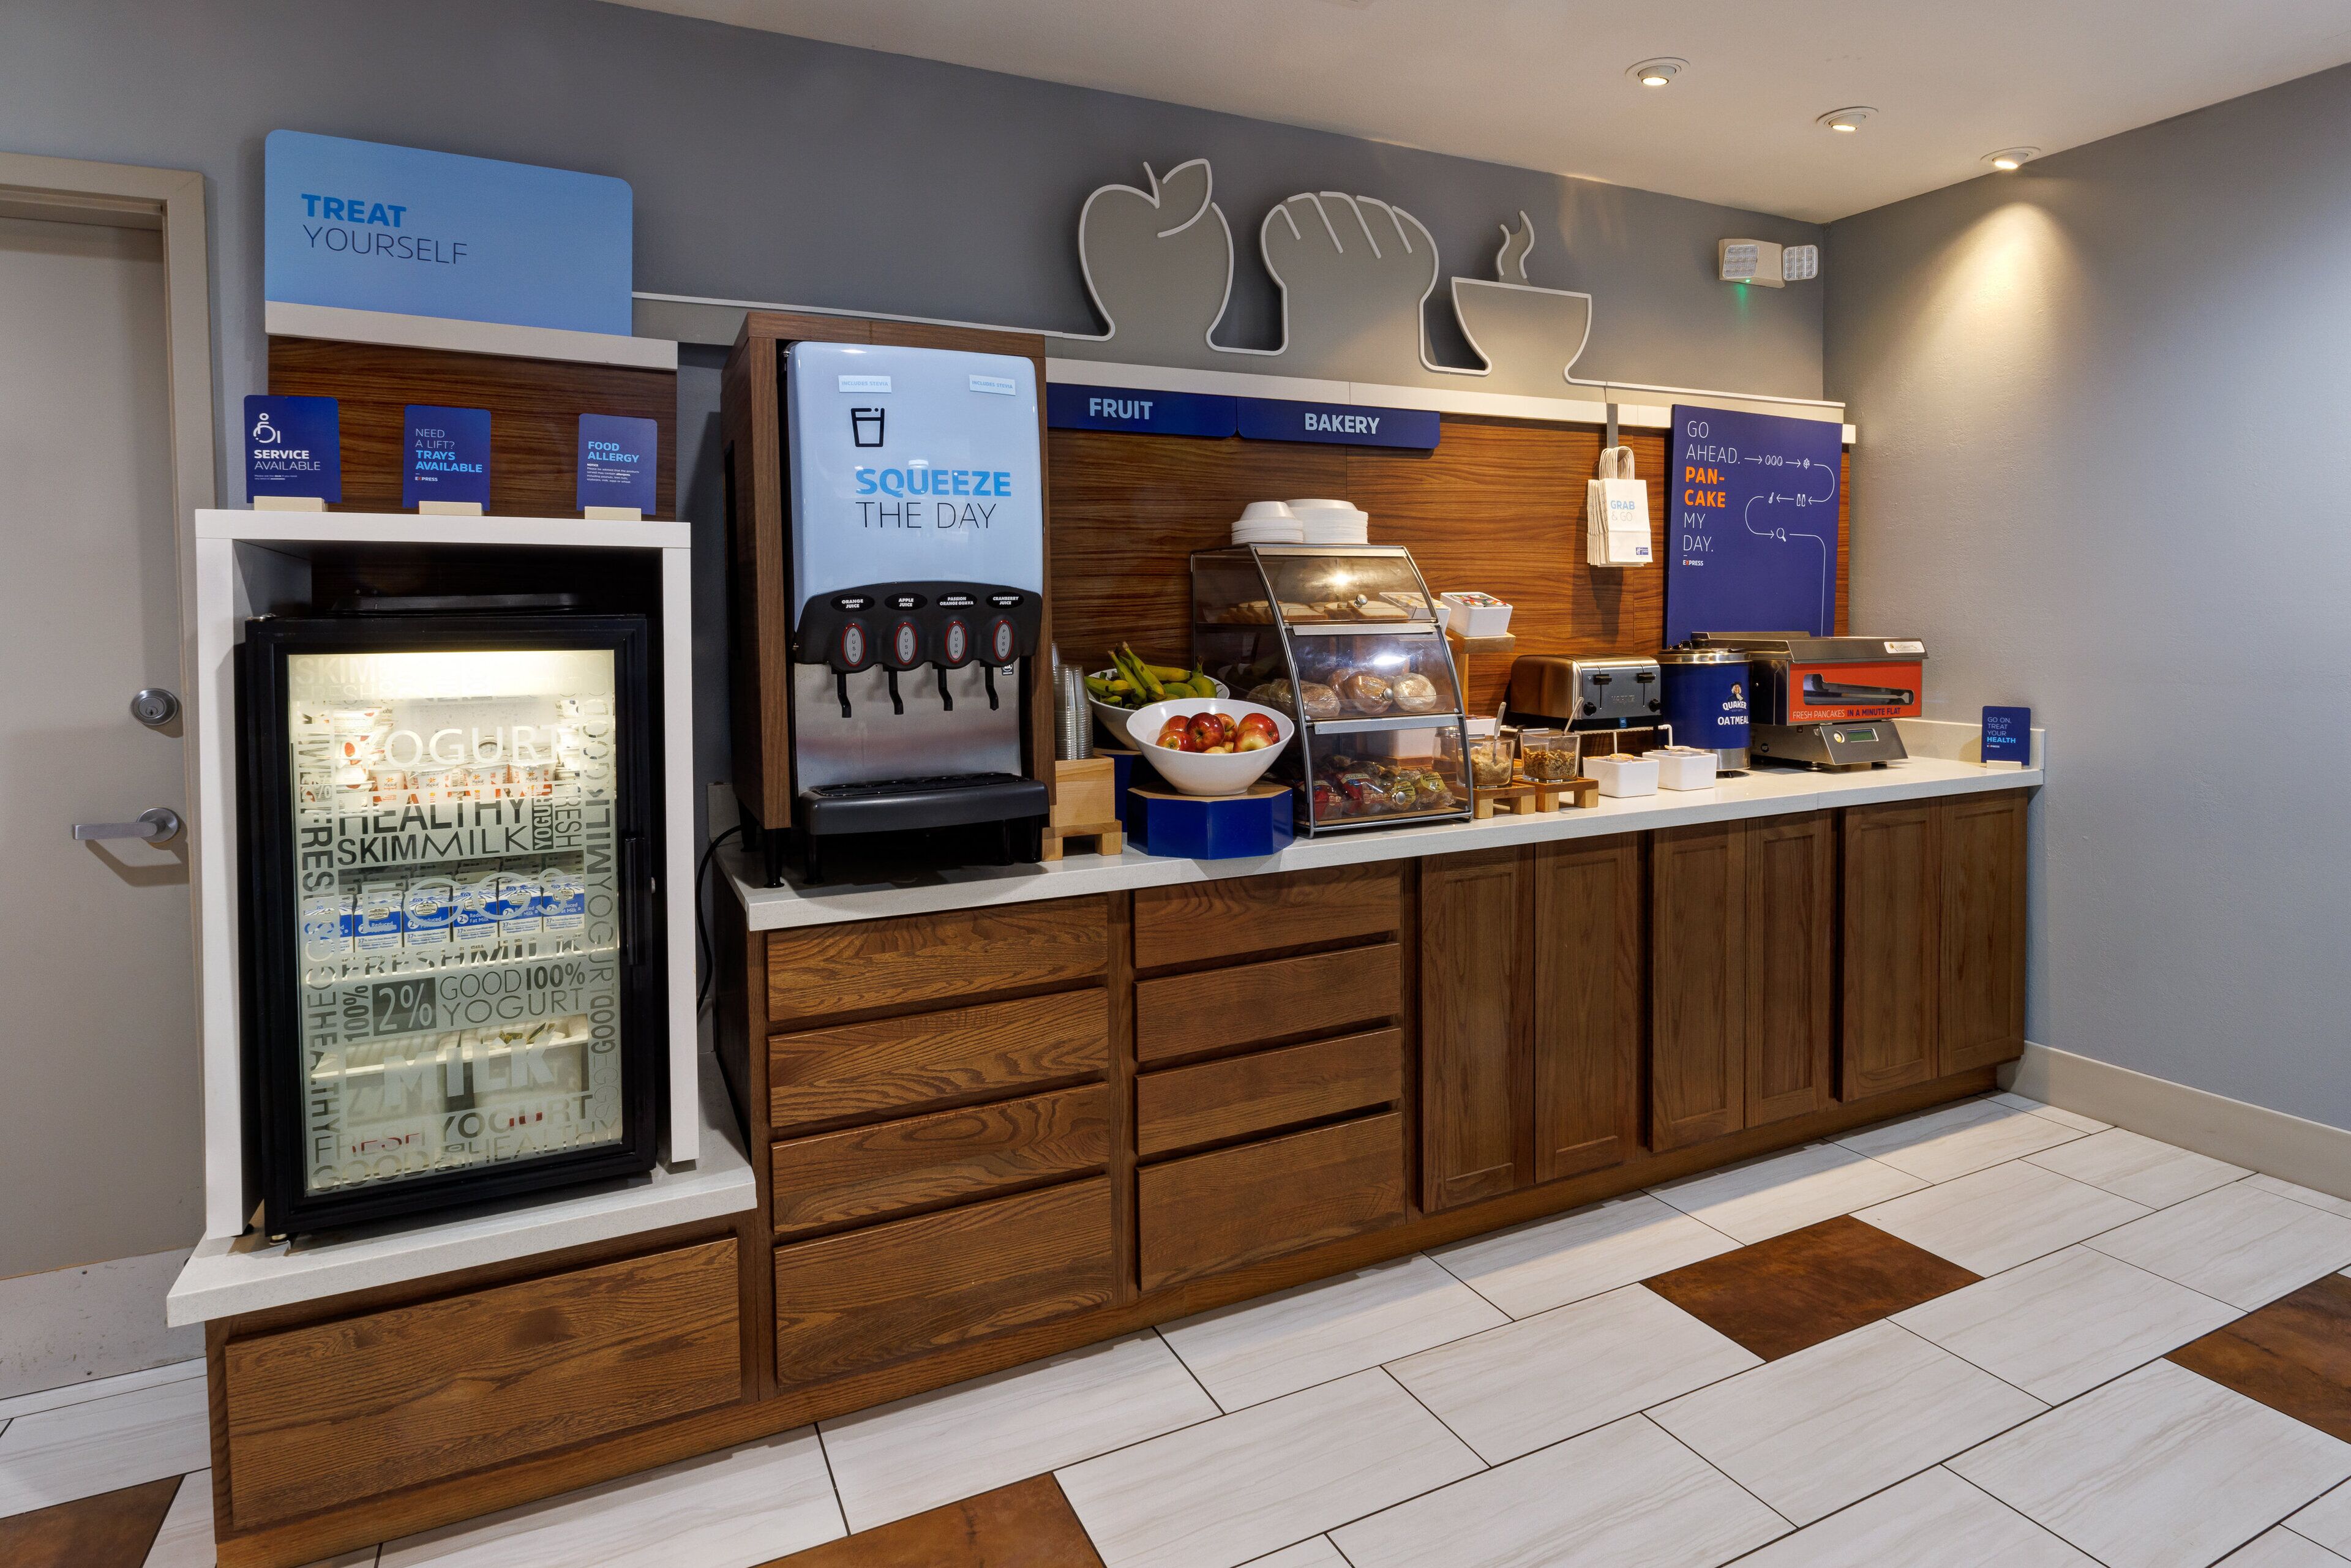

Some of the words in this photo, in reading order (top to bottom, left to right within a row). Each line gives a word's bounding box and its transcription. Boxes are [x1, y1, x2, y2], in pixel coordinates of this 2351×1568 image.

[302, 193, 406, 227] TREAT
[302, 225, 467, 264] YOURSELF
[1089, 397, 1152, 420] FRUIT
[416, 429, 445, 438] NEED
[1305, 413, 1380, 434] BAKERY
[1687, 421, 1709, 438] GO
[254, 450, 310, 459] SERVICE
[416, 450, 456, 460] TRAYS
[427, 440, 455, 449] LIFT?
[588, 441, 620, 451] FOOD
[1685, 444, 1741, 465] AHEAD.
[255, 461, 321, 470] AVAILABLE
[415, 461, 482, 473] AVAILABLE
[588, 452, 639, 463] ALLERGY
[855, 468, 1011, 498] SQUEEZE
[1685, 467, 1725, 484] PAN-
[1611, 500, 1635, 510] GRAB
[1684, 489, 1726, 508] CAKE
[855, 501, 922, 528] THE
[937, 503, 996, 528] DAY
[1611, 511, 1618, 520] &
[1620, 512, 1633, 522] GO
[1684, 512, 1706, 529] MY
[1682, 535, 1714, 552] DAY.
[295, 657, 375, 685] SKIM
[1722, 701, 1747, 710] QUAKER
[1814, 709, 1845, 718] PANCAKES
[1717, 716, 1749, 726] OATMEAL
[339, 788, 527, 837] HEALTHY
[585, 787, 612, 875] MILK
[362, 868, 566, 934] EGGS
[440, 969, 521, 1000] GOOD
[526, 961, 585, 991] 100%
[343, 985, 369, 1042] 100%
[378, 983, 432, 1032] 2%
[442, 987, 583, 1026] YOGURT
[590, 995, 616, 1054] GOOD
[383, 1036, 555, 1106] MILK
[593, 1052, 619, 1119] EGGS
[438, 1095, 593, 1141] YOGURT
[312, 1151, 430, 1192] GOOD
